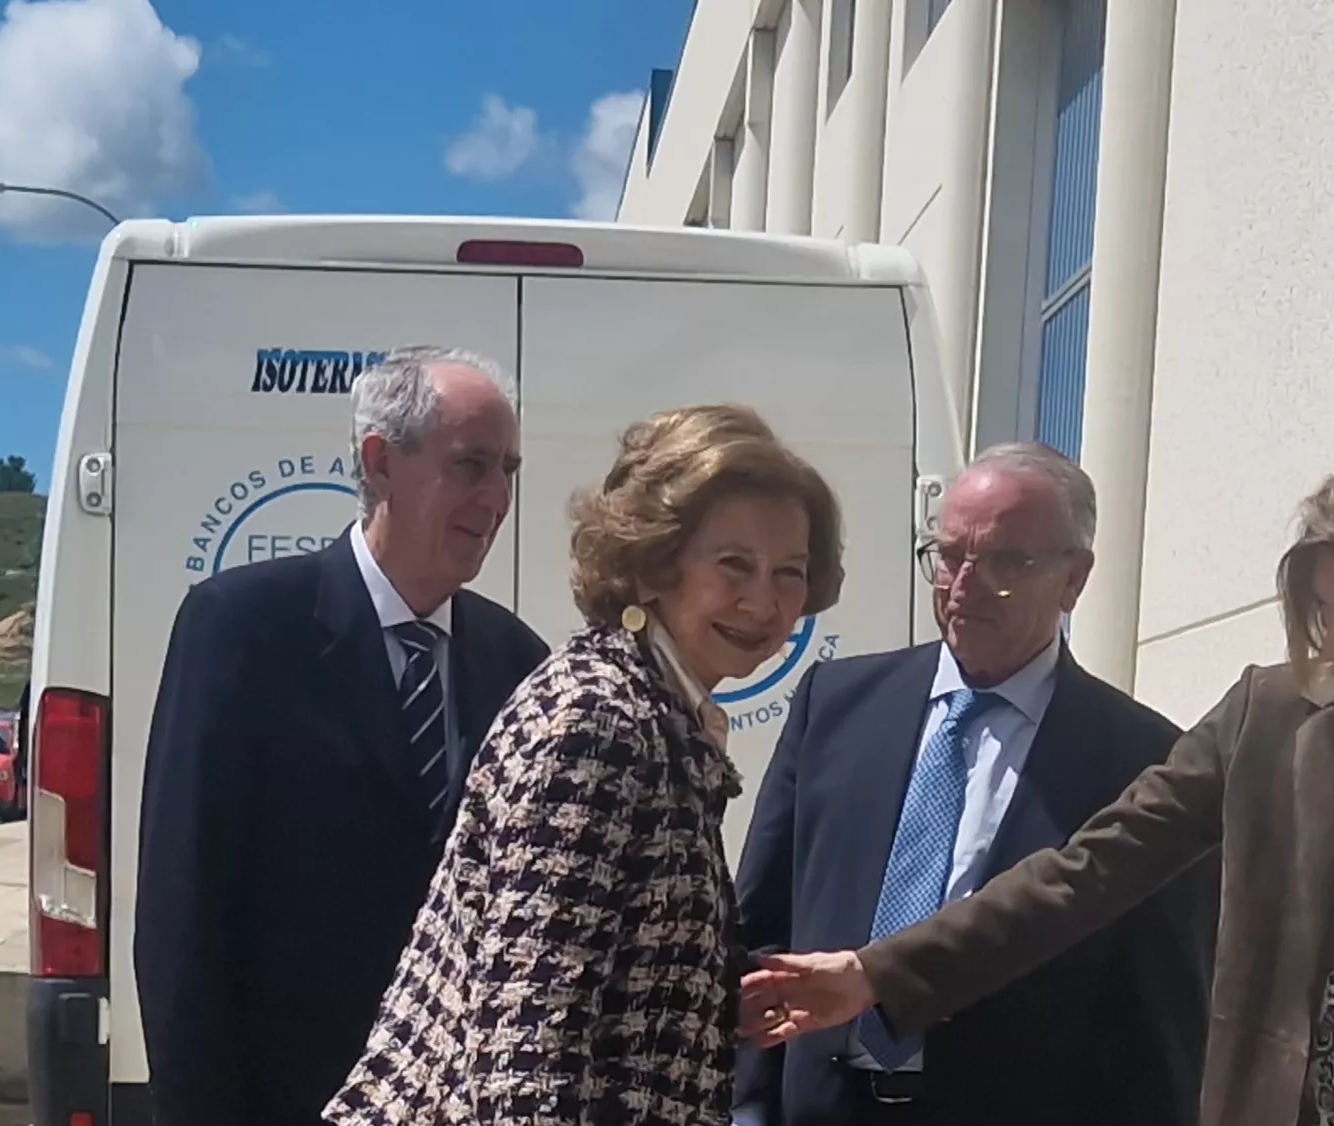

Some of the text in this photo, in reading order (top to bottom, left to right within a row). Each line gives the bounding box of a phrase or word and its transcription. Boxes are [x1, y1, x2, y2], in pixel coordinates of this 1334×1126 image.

[186, 470, 267, 572] BANCOS
[278, 456, 315, 478] DE
[731, 701, 784, 731] NTOS
